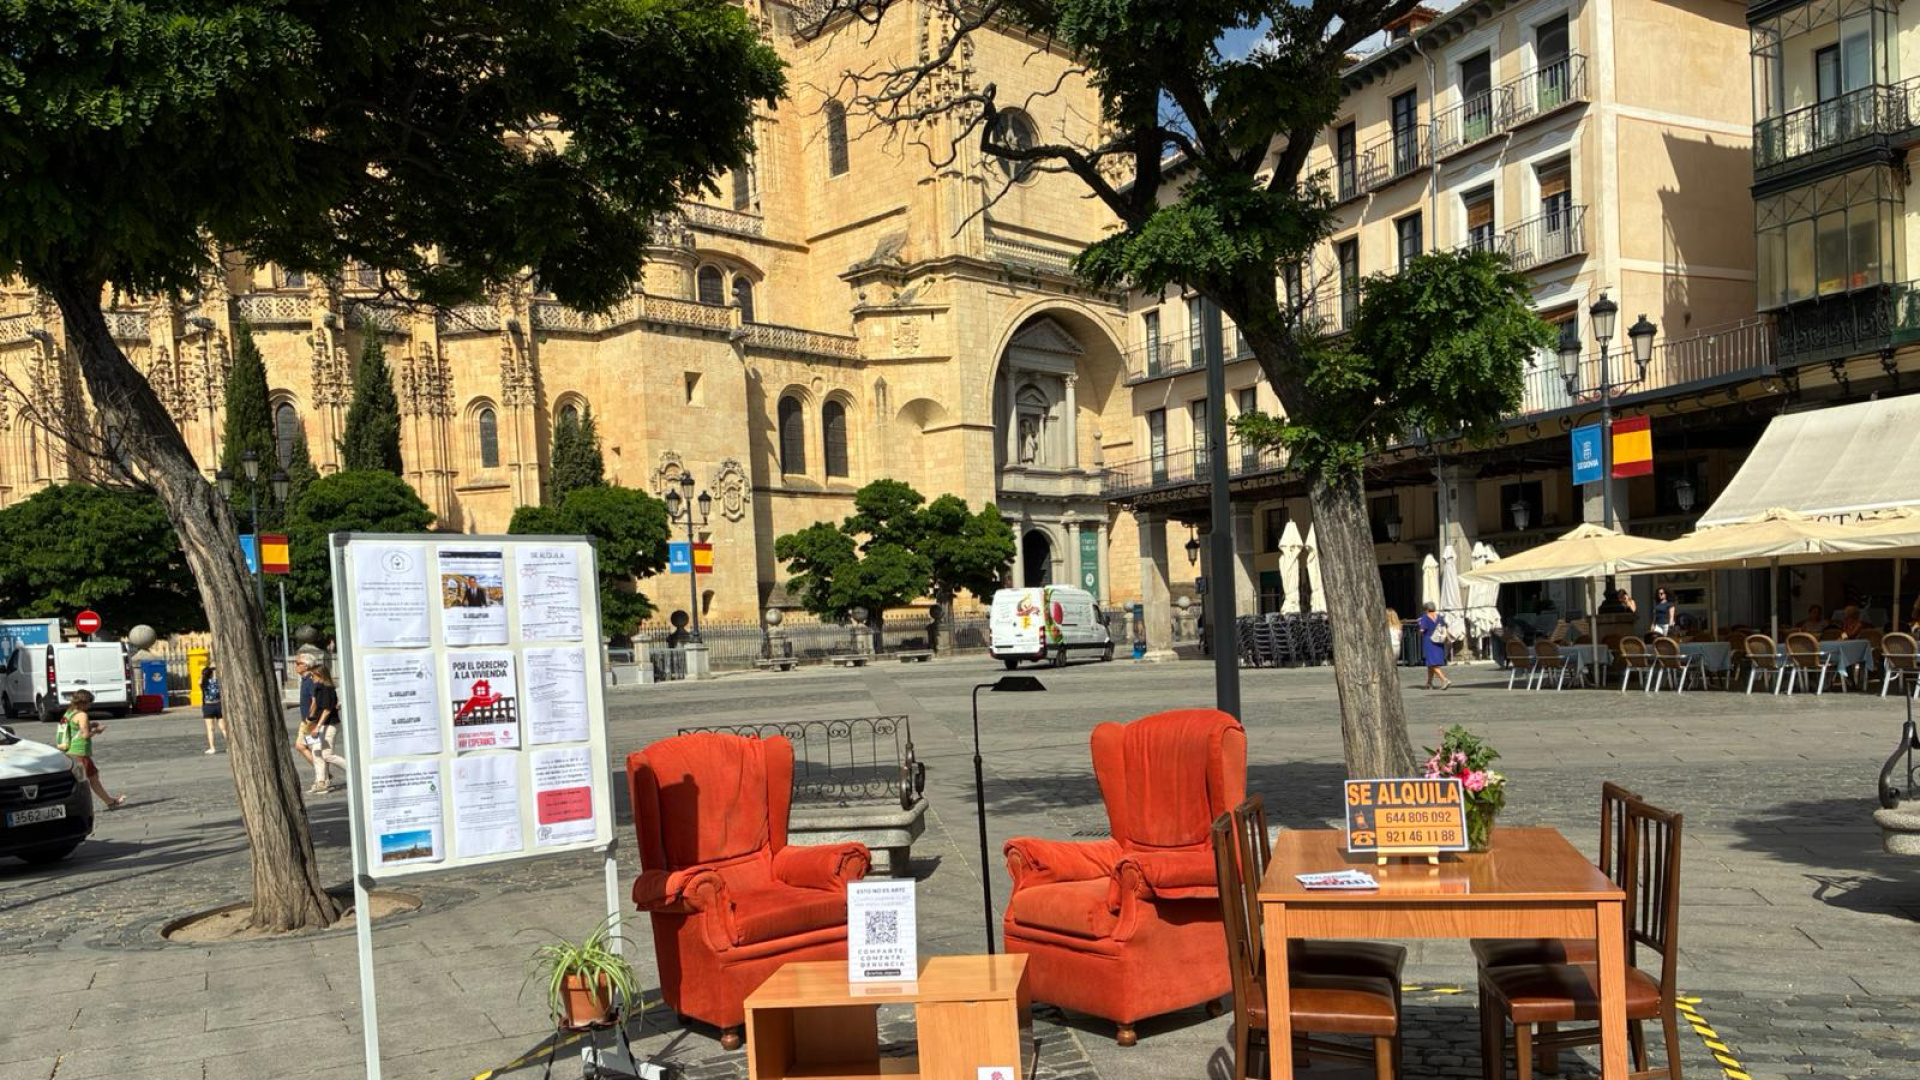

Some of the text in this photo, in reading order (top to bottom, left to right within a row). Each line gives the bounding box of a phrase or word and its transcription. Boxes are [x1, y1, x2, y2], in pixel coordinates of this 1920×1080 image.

[452, 659, 509, 671] POR EL DERECHO
[461, 670, 471, 679] LA
[471, 669, 507, 679] VIVIENDA
[1348, 782, 1460, 806] SE ALQUILA
[1386, 811, 1451, 823] 644 806 092
[1386, 829, 1455, 842] 921 46 11 88
